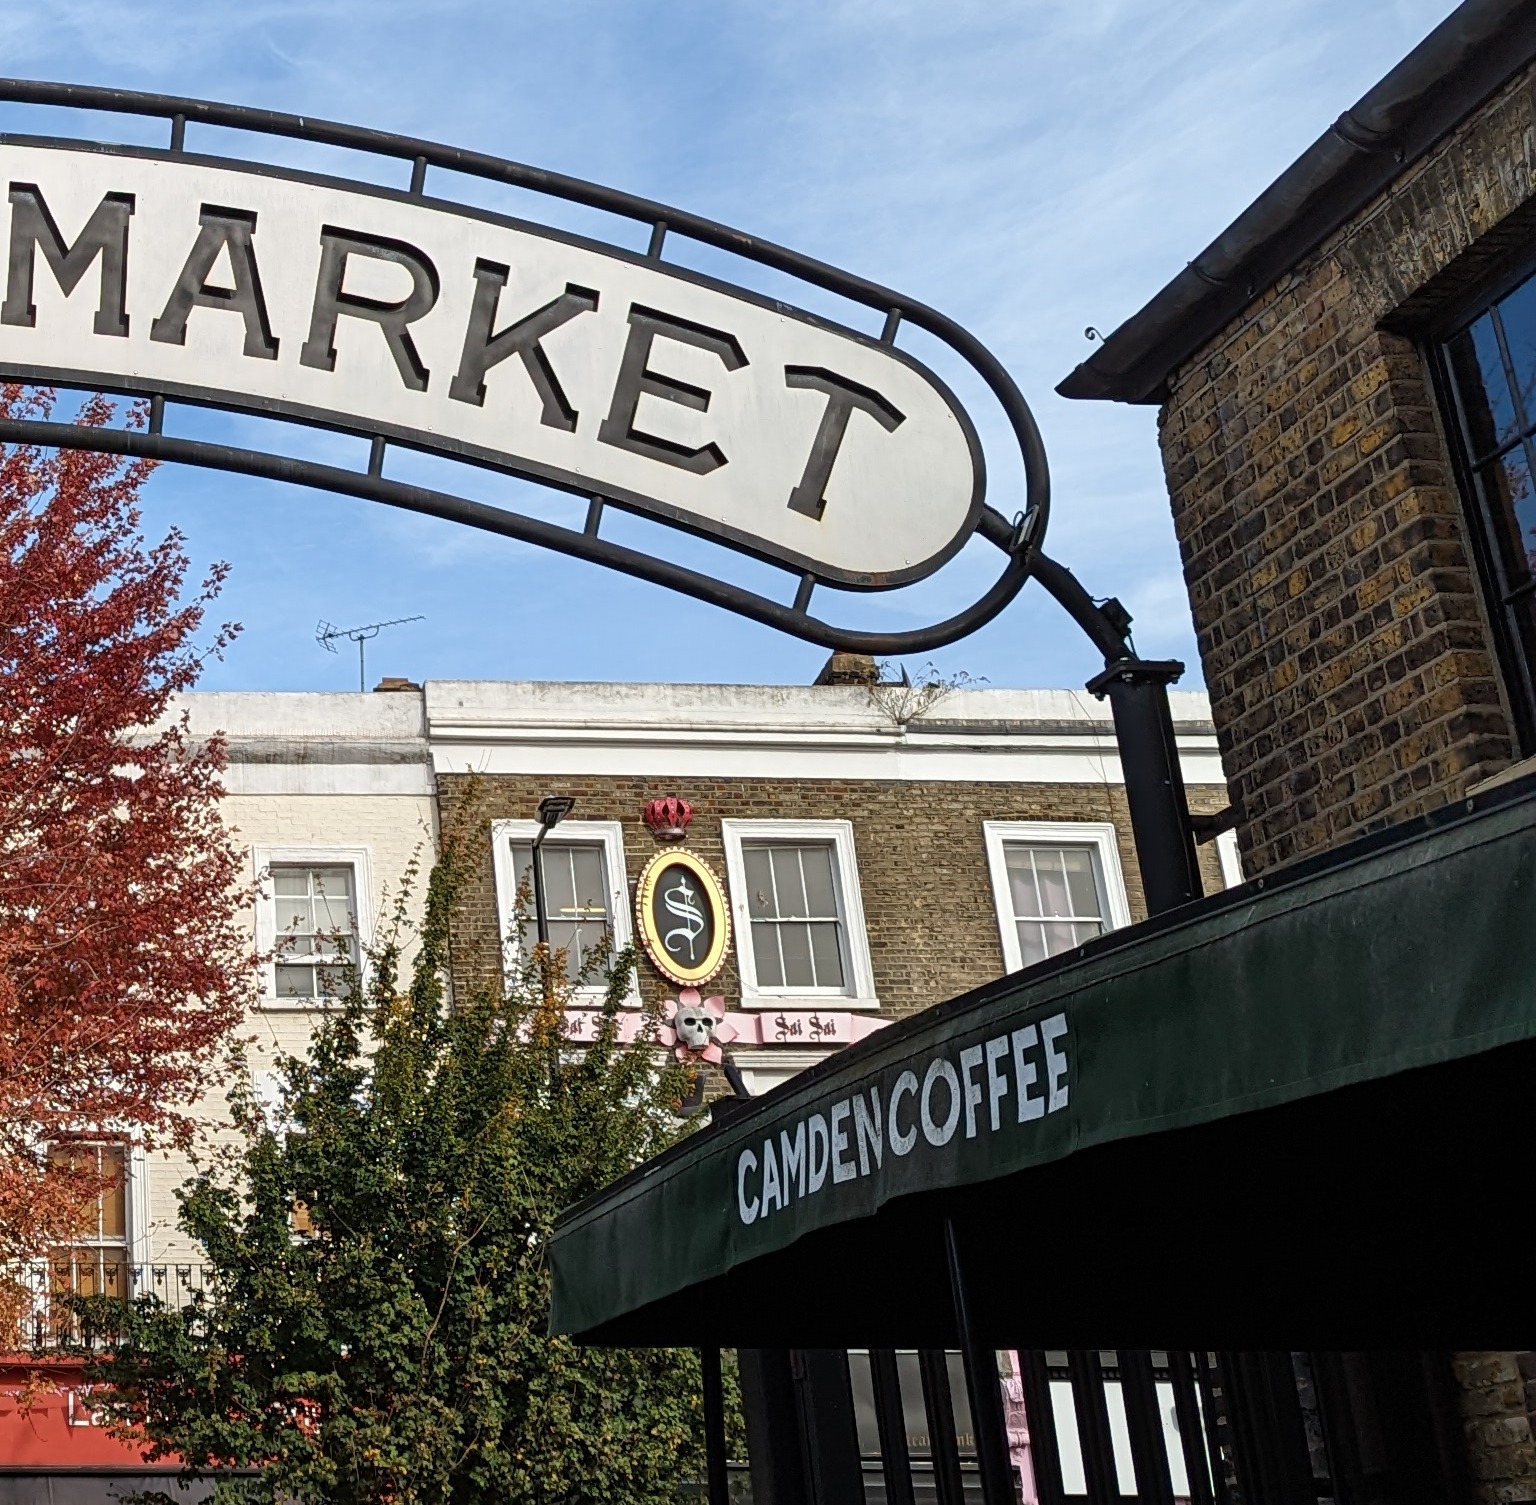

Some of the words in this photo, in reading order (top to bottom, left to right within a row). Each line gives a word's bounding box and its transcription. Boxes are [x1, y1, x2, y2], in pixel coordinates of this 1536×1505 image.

[0, 181, 907, 522] MARKET
[775, 1012, 803, 1042] Sai
[809, 1012, 836, 1042] Sai
